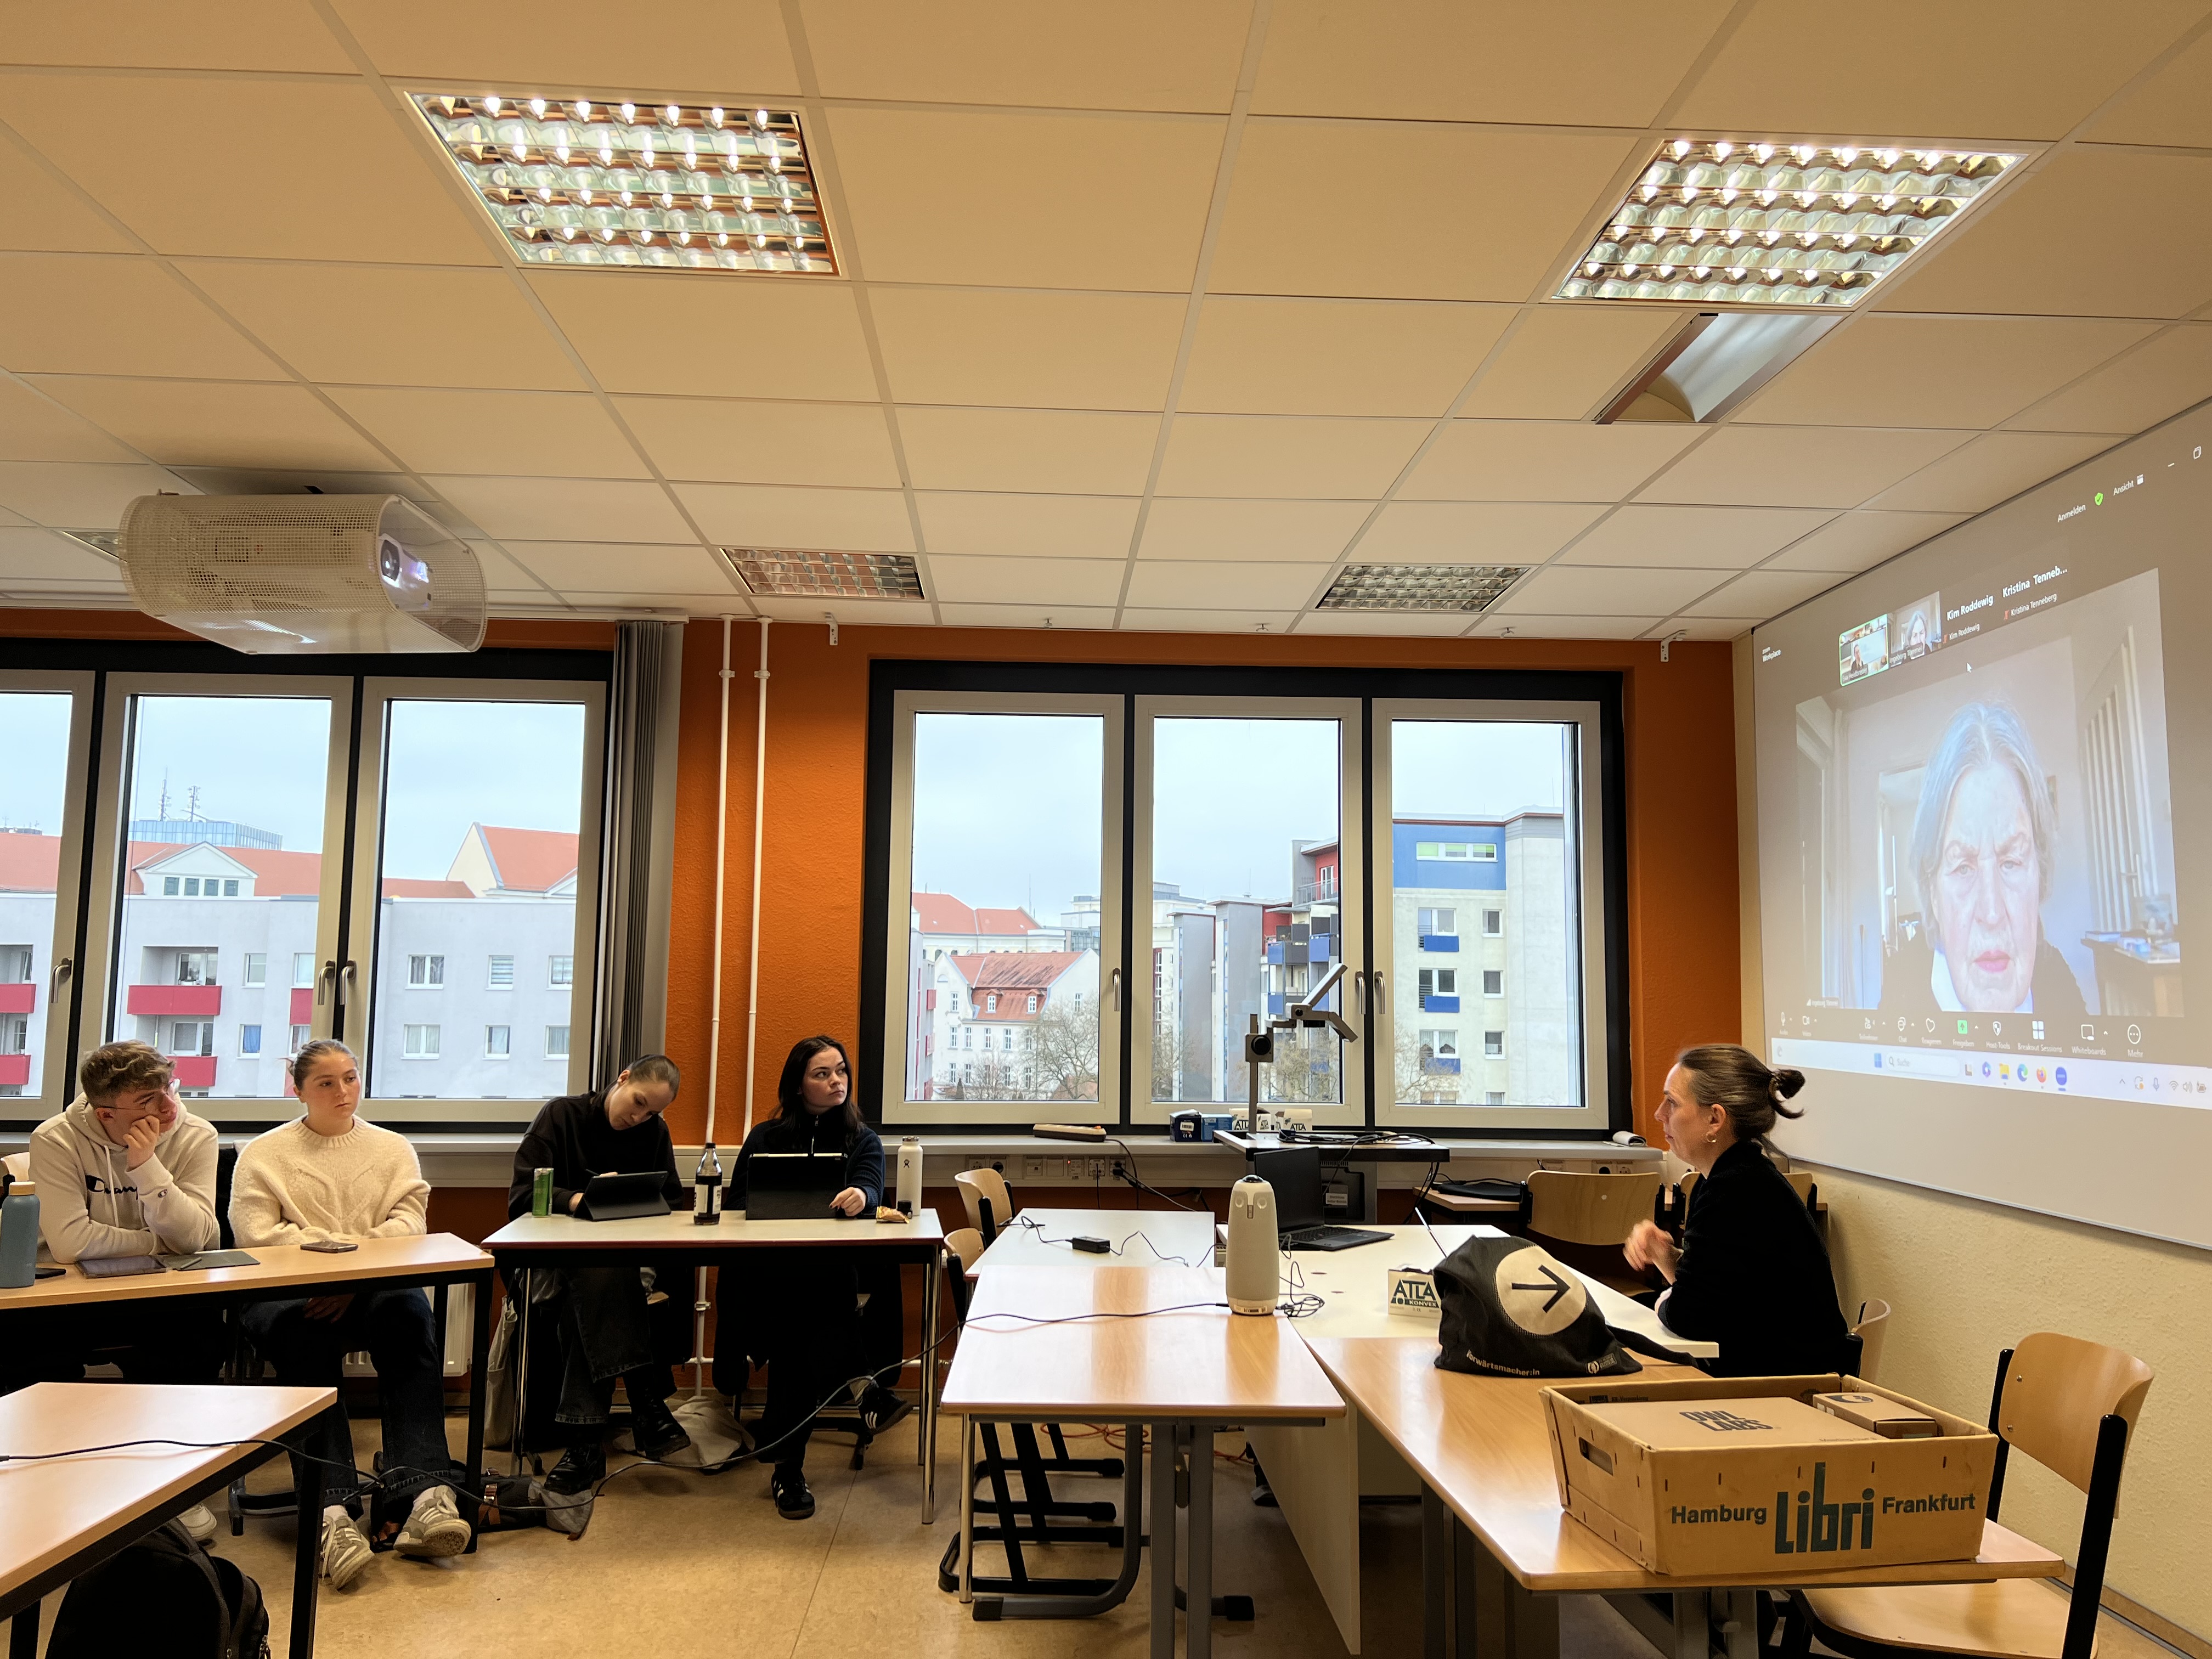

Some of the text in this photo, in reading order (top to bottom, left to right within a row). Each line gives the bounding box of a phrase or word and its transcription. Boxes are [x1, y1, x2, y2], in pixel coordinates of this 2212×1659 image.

[2113, 479, 2134, 496] Ansicht
[2057, 504, 2086, 523] Anmelden
[2002, 566, 2068, 598] Kristina Tenneb...
[1946, 595, 1994, 621] Kim Roddewig
[2011, 593, 2057, 617] Kristina Tenneberg
[1949, 623, 1980, 641] Kim Roddewig
[2017, 1042, 2040, 1052] Breakout
[2072, 1046, 2107, 1056] Whiteboards
[2128, 1049, 2143, 1058] Mehr
[1235, 1120, 1249, 1130] ATL
[1393, 1278, 1437, 1301] ATLA
[1679, 1410, 1746, 1421] OWL
[1696, 1419, 1774, 1431] LABS
[1671, 1462, 1976, 1555] Hamburg Libri Frankfurt
